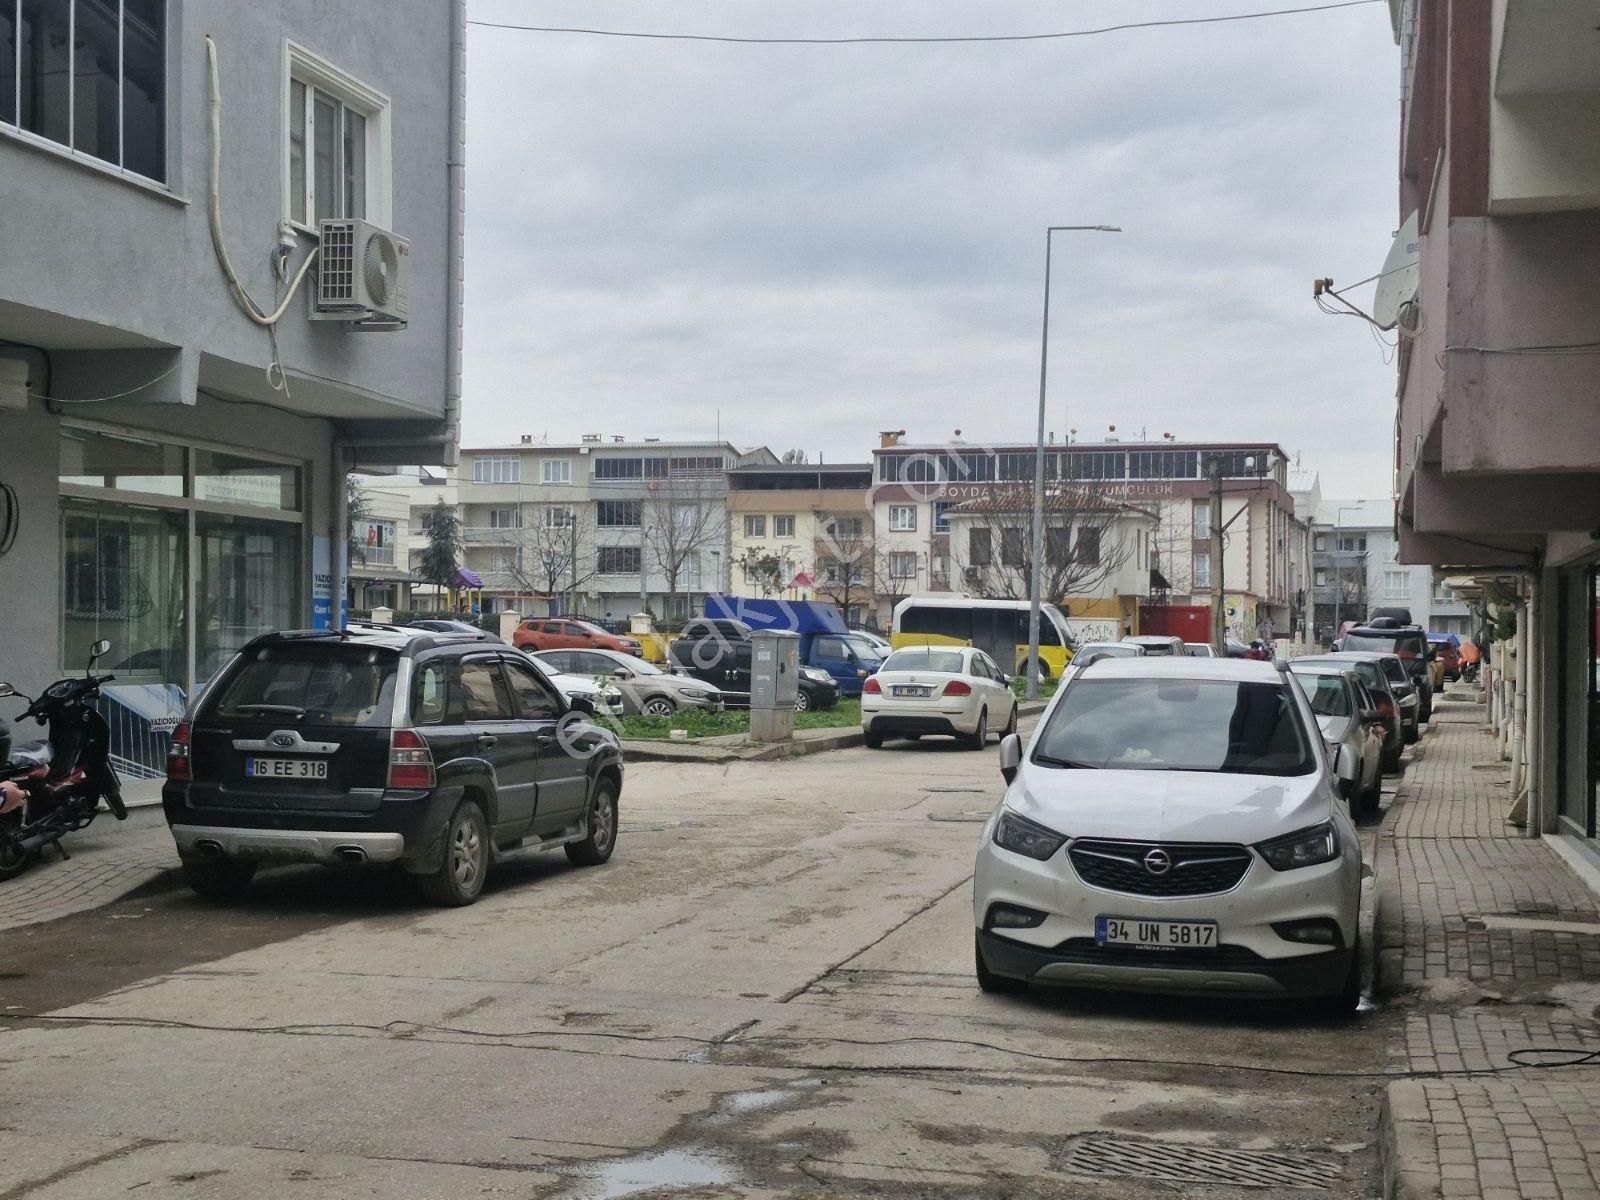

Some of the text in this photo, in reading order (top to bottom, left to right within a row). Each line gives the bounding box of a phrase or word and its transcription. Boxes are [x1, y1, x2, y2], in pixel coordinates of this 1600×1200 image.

[254, 760, 326, 777] 16 EE 318
[1108, 921, 1214, 945] 34 UN 5817
